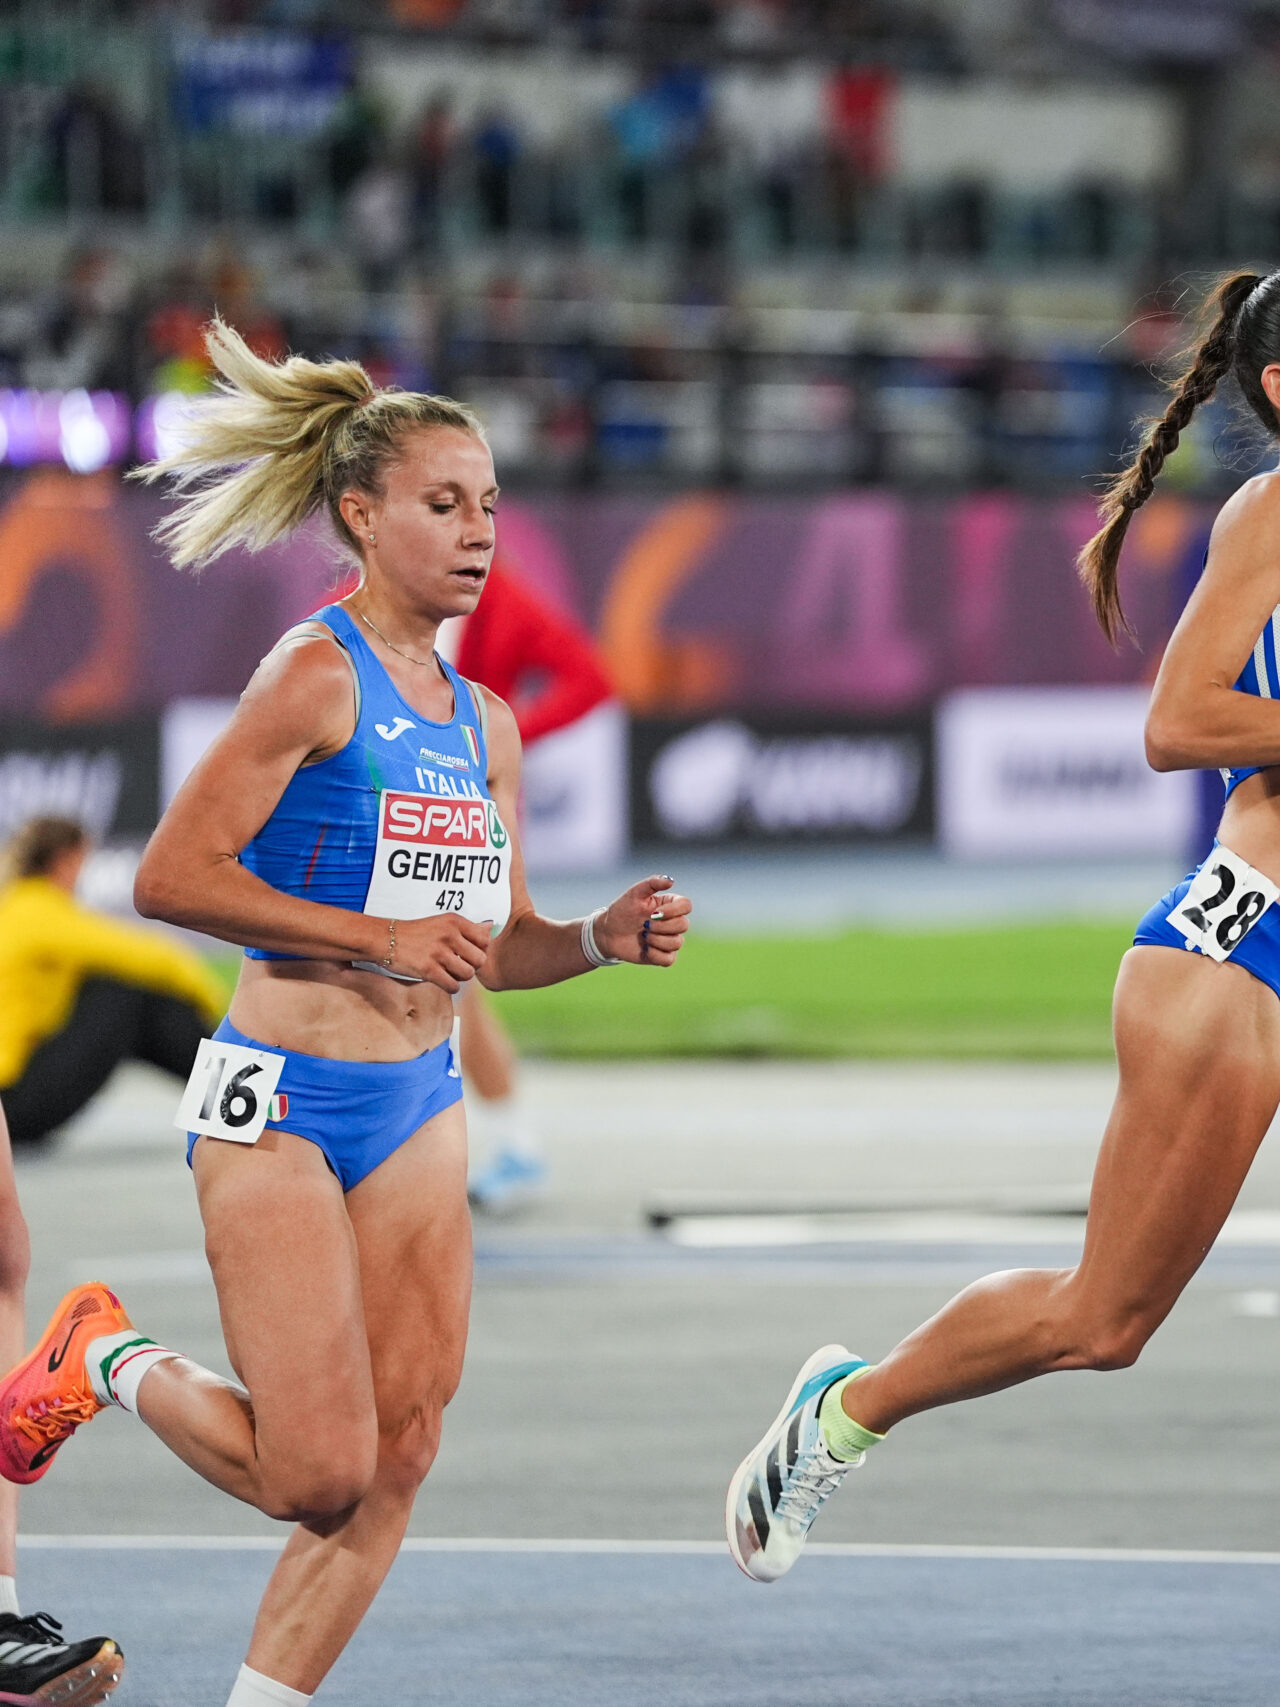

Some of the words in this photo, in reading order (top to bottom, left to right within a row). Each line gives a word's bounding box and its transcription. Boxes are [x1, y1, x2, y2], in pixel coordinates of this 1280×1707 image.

[420, 747, 469, 768] FRECCIAROSSA
[415, 767, 483, 799] ITALIA
[388, 800, 486, 841] SPAR
[388, 849, 501, 885] GEMETTO
[435, 889, 464, 912] 473
[1181, 863, 1266, 952] 28
[198, 1057, 264, 1128] 16
